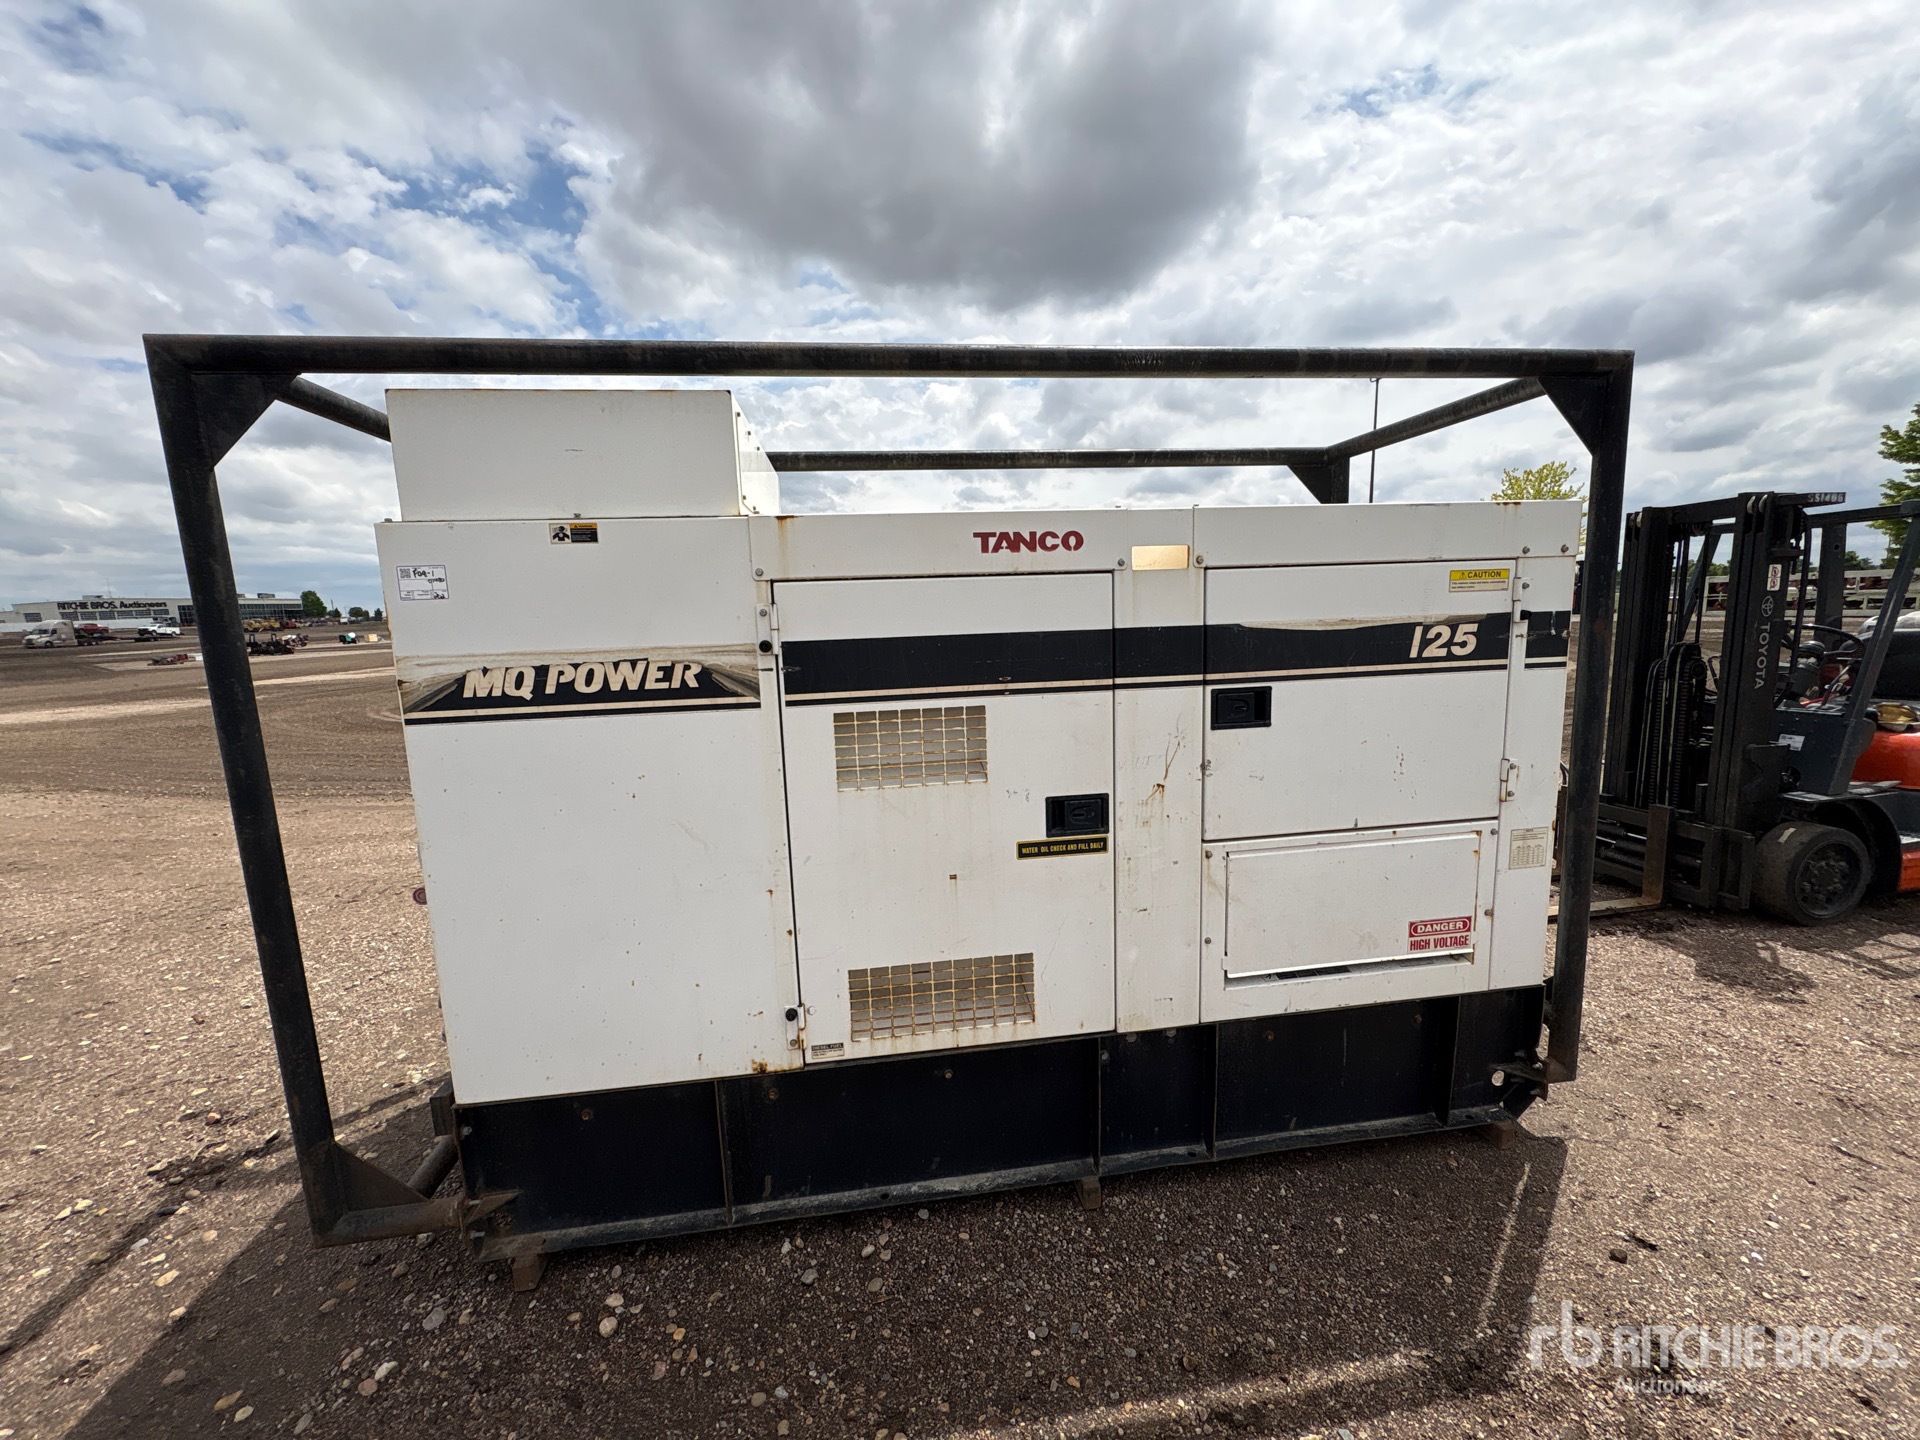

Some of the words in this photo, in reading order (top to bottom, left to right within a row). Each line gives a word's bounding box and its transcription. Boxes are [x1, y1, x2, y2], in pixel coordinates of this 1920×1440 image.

[972, 530, 1085, 554] TANCO
[1467, 571, 1502, 579] CAUTION
[57, 601, 90, 611] RITCHIE
[90, 601, 118, 610] BROS.
[119, 601, 167, 609] Auctioneers
[1408, 622, 1479, 659] 125
[1754, 621, 1771, 689] TOYOTA
[462, 665, 536, 701] MQ
[544, 659, 703, 695] POWER
[1021, 846, 1039, 855] WATER
[1040, 845, 1049, 853] OIL
[1050, 844, 1067, 852] CHECK
[1067, 843, 1078, 851] AND
[1078, 842, 1089, 850] FILL
[1089, 841, 1104, 850] DAILY
[1416, 920, 1465, 934] DANGER
[1409, 938, 1431, 952] HIGH
[1433, 934, 1470, 949] VOLTAGE
